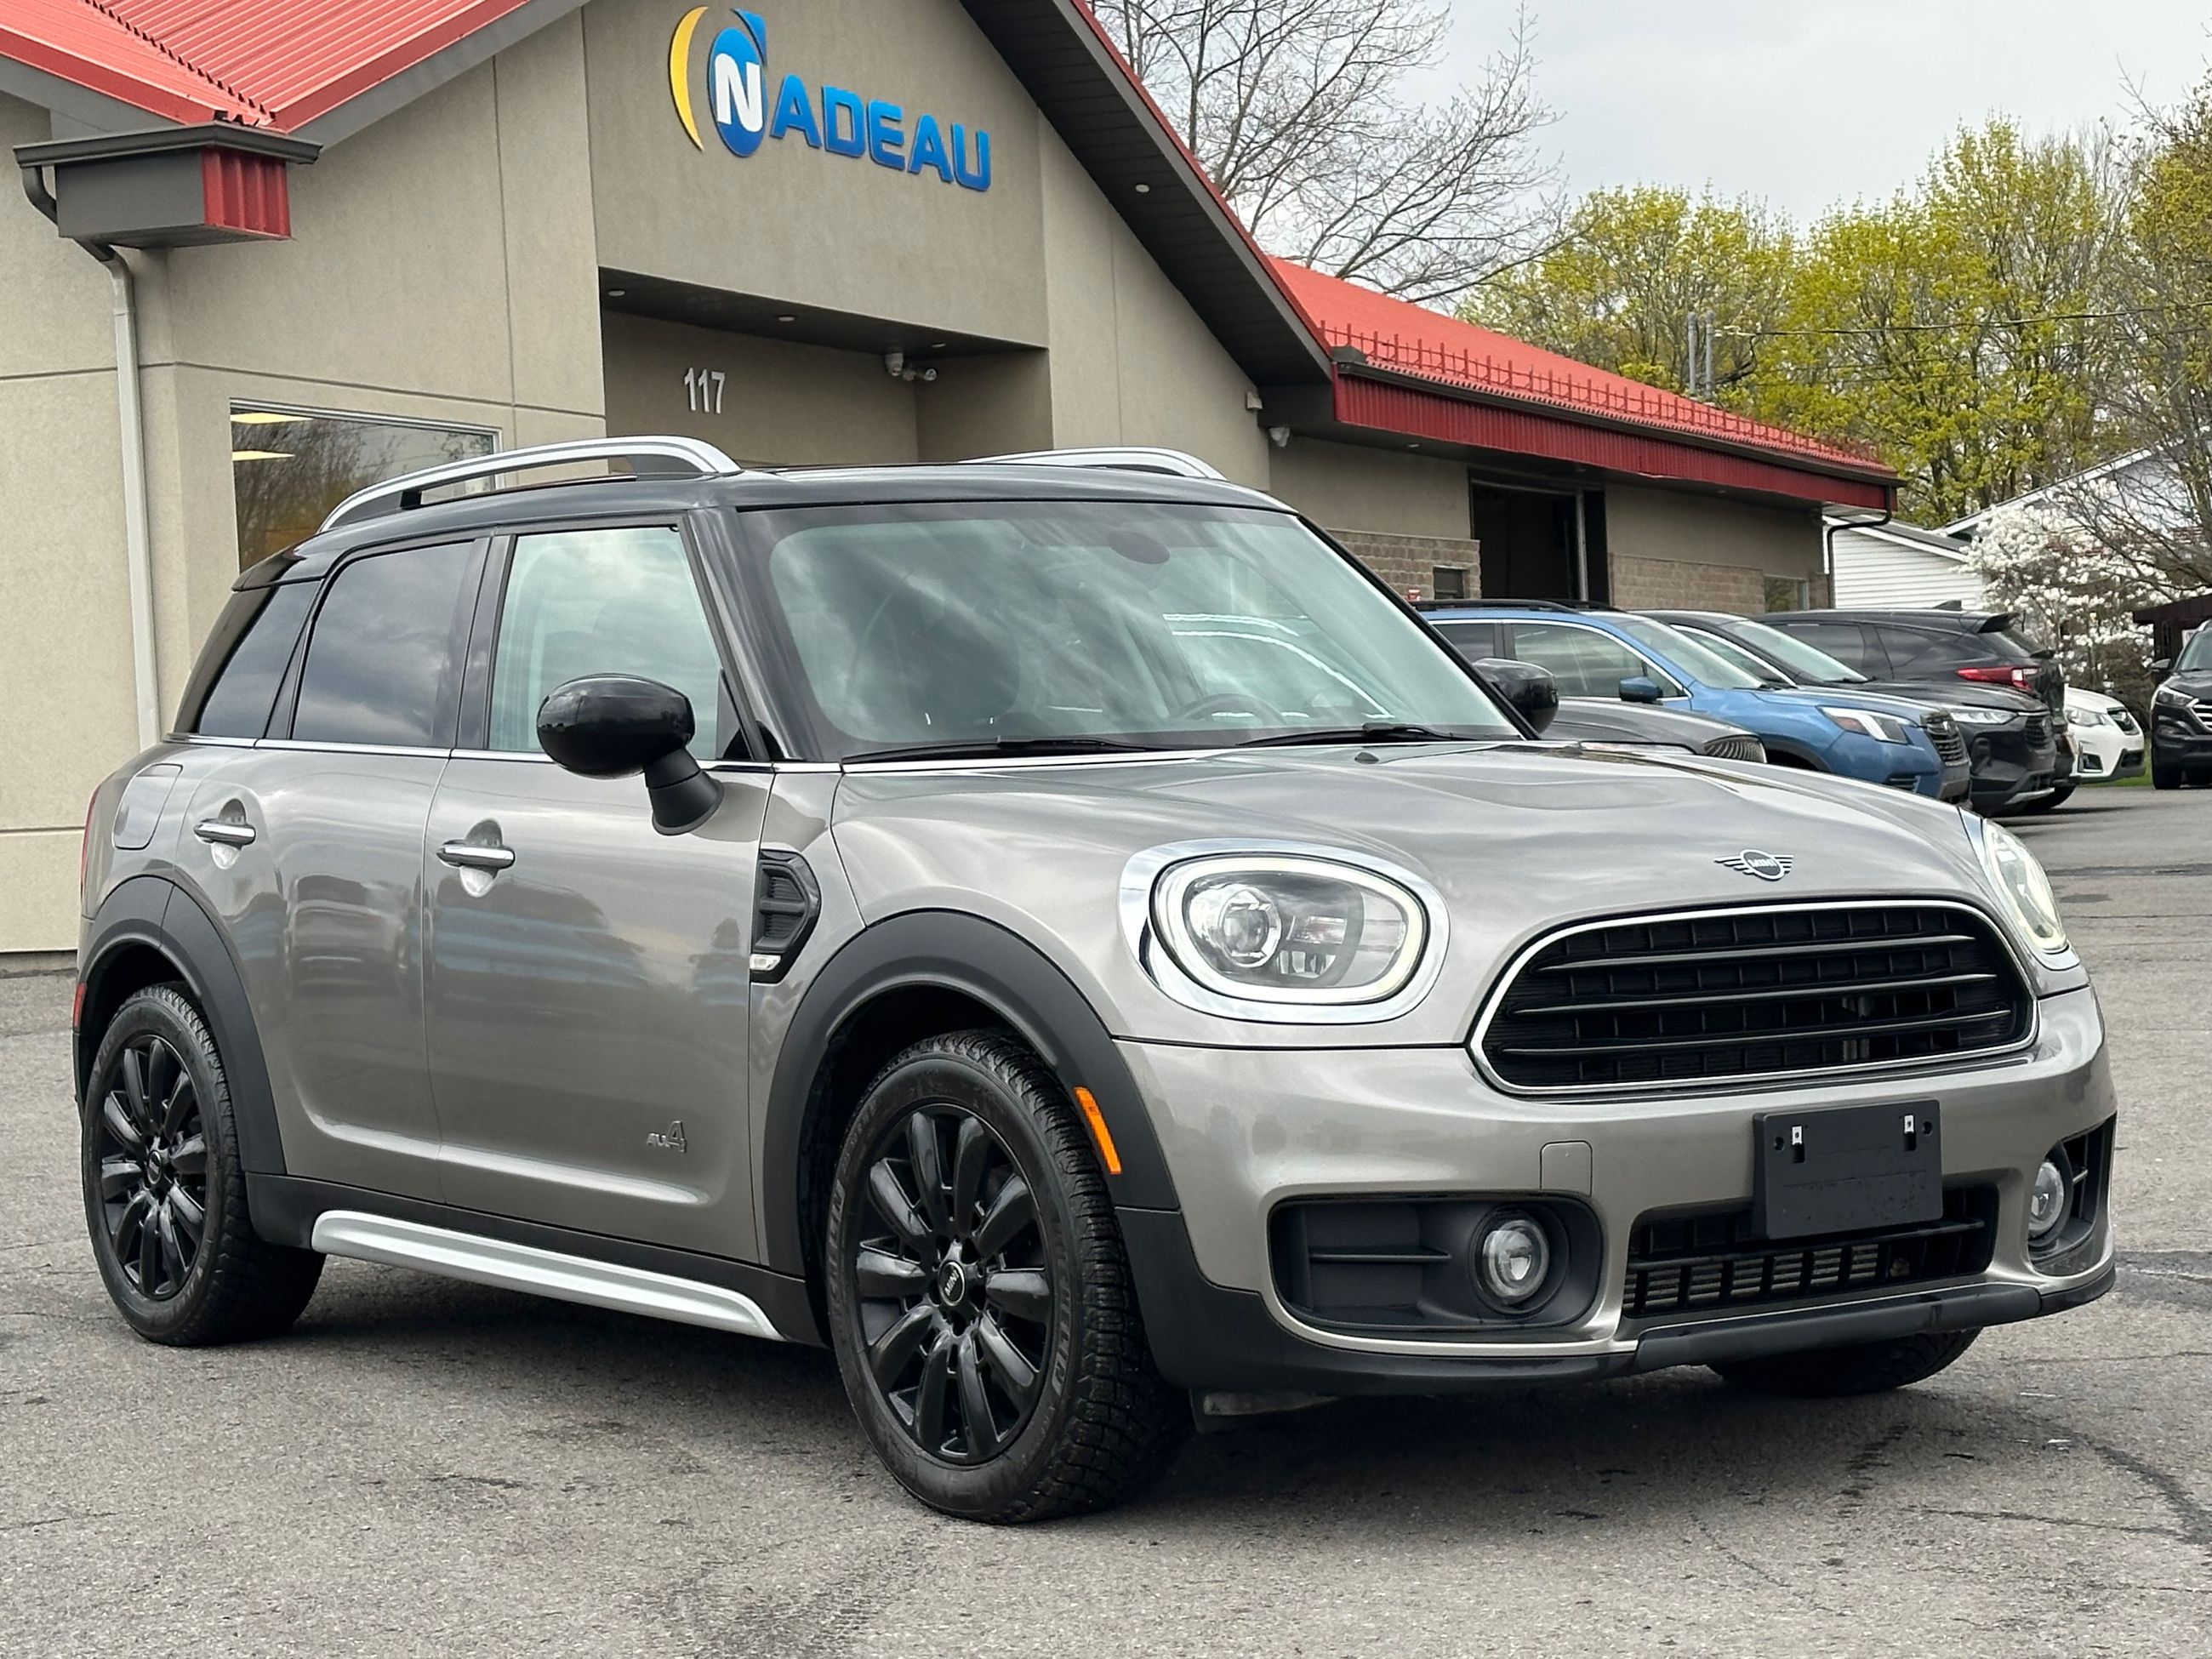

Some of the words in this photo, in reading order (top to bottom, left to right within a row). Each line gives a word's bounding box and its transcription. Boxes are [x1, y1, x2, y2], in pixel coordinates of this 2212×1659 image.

[712, 52, 992, 192] NADEAU
[684, 367, 725, 414] 117
[944, 1268, 960, 1297] MINI
